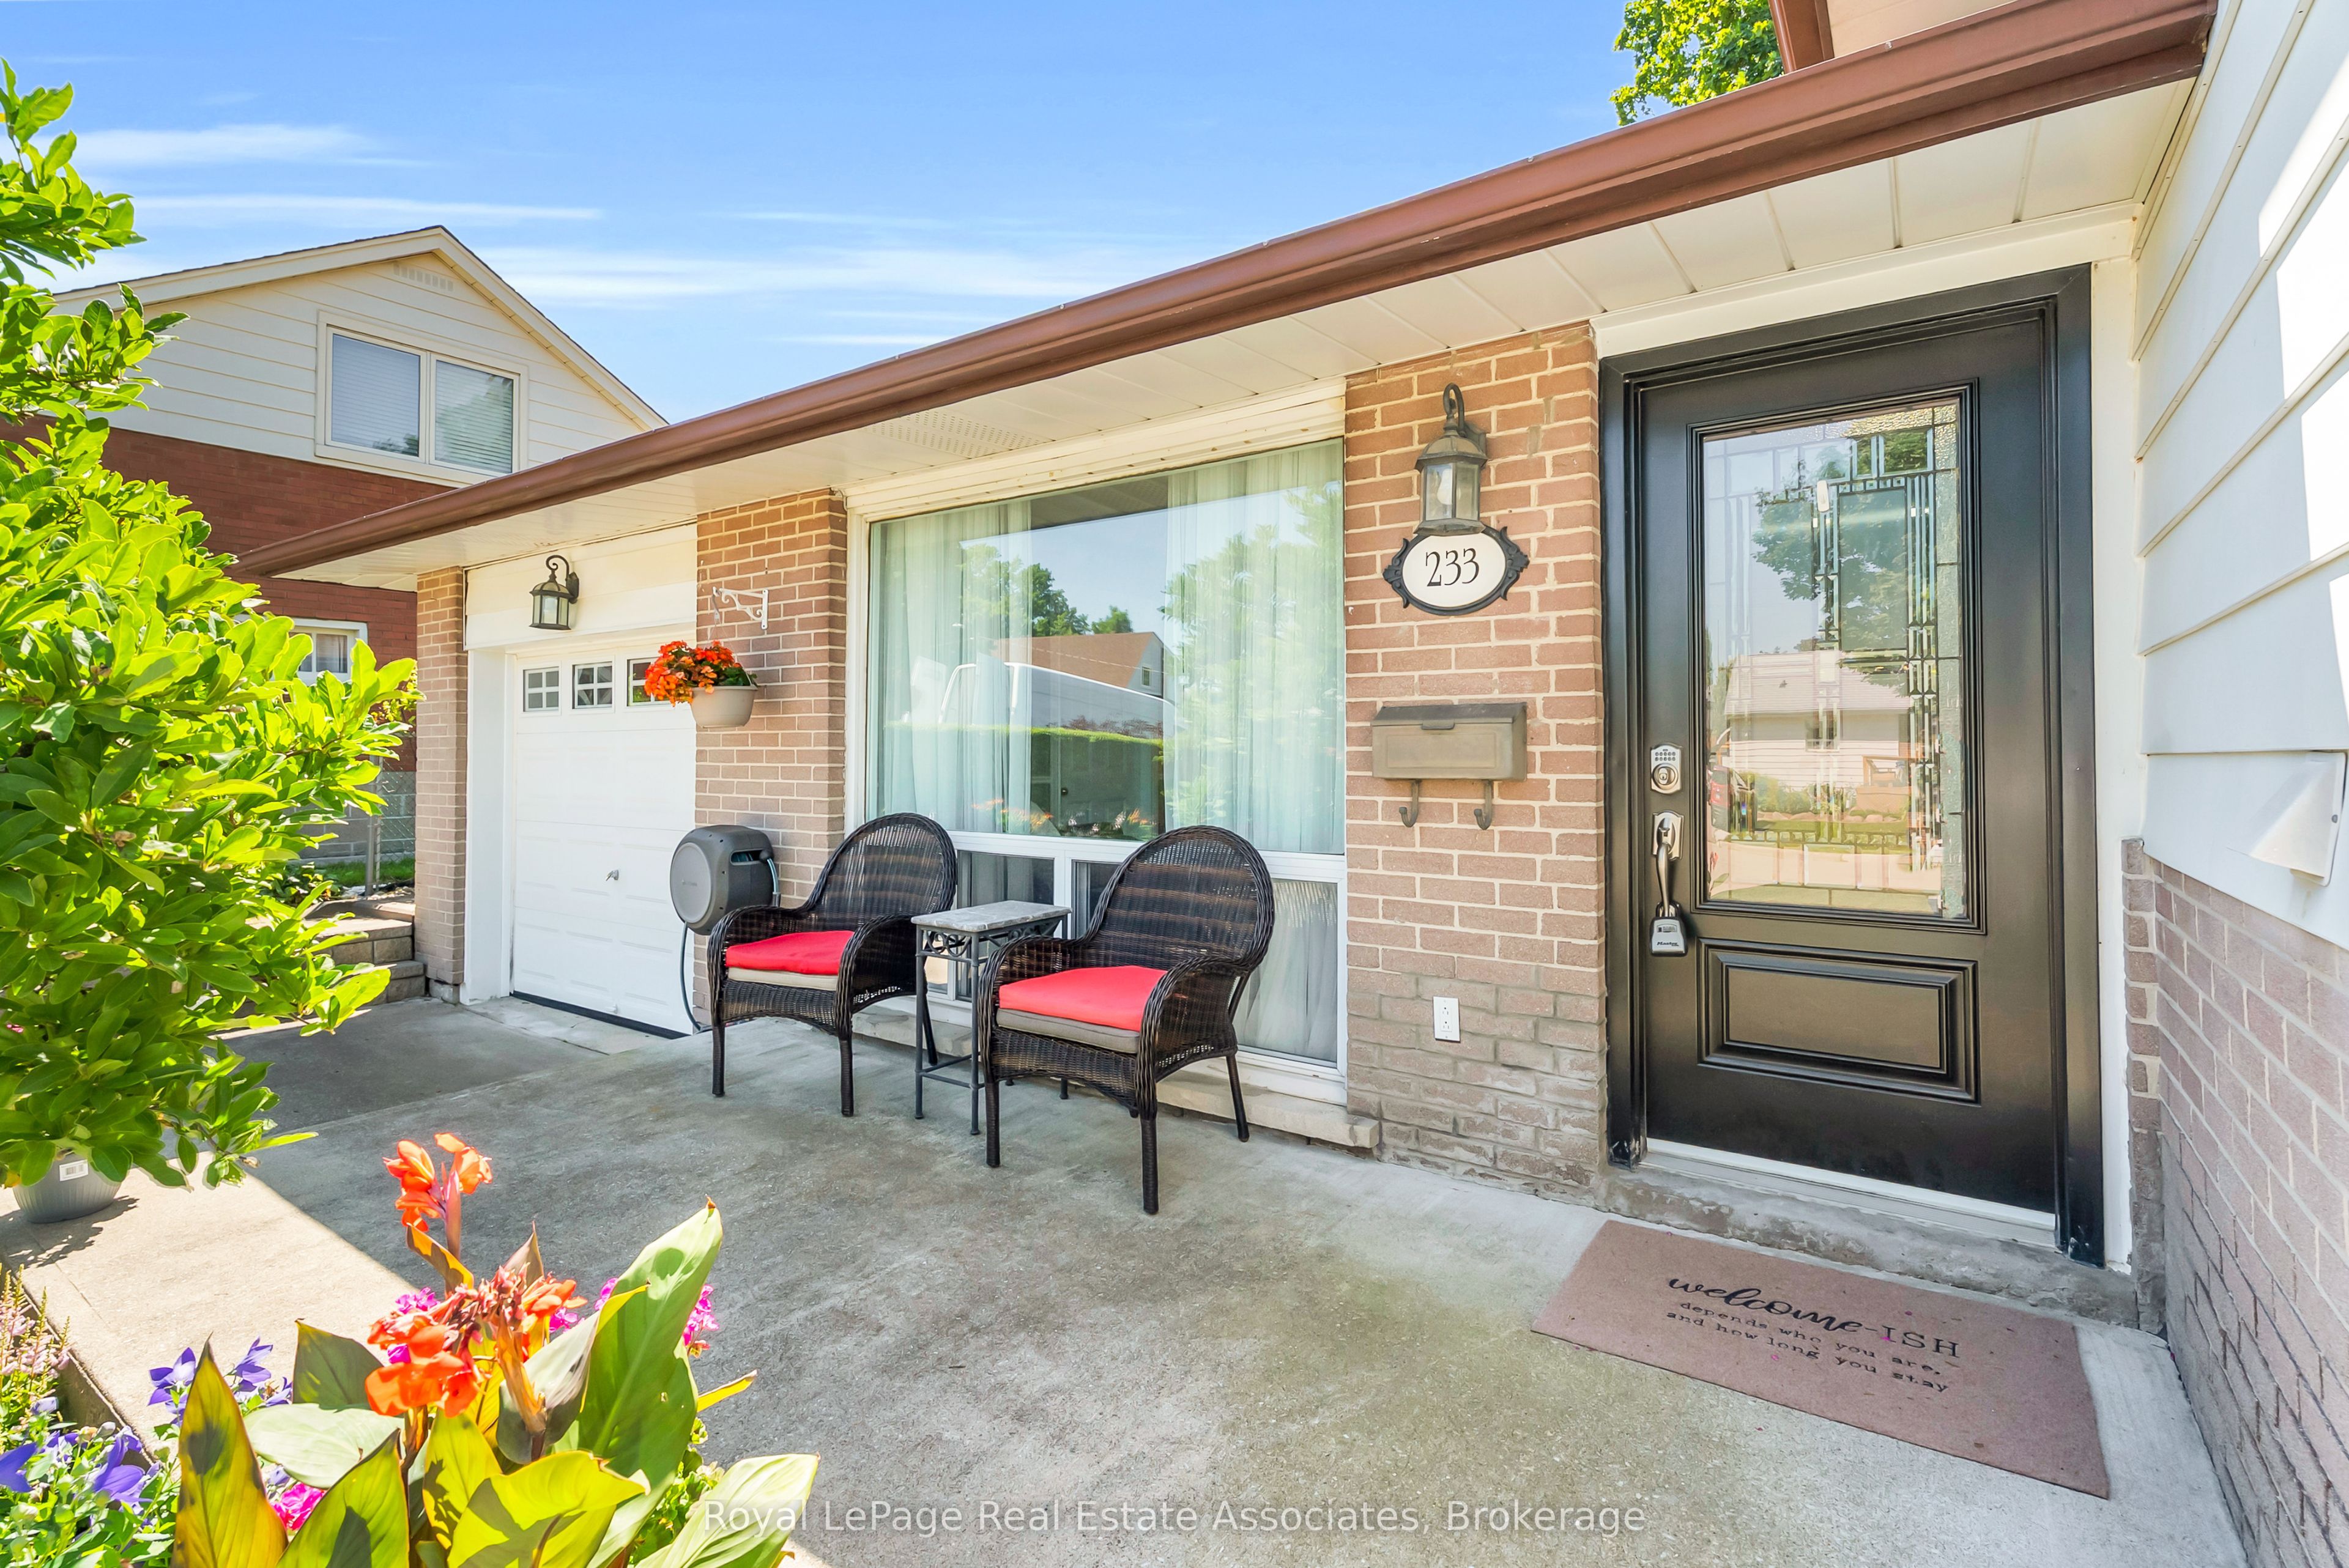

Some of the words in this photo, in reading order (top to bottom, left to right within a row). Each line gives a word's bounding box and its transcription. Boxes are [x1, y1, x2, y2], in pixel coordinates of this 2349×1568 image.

[1425, 548, 1479, 586] 233
[1666, 1312, 1704, 1326] and
[1716, 1323, 1758, 1339] how
[1767, 1337, 1820, 1359] long
[1835, 1356, 1877, 1374] you
[1892, 1372, 1948, 1392] stay
[1680, 1302, 1767, 1329] depends
[1779, 1328, 1821, 1343] who
[1836, 1342, 1876, 1358] you
